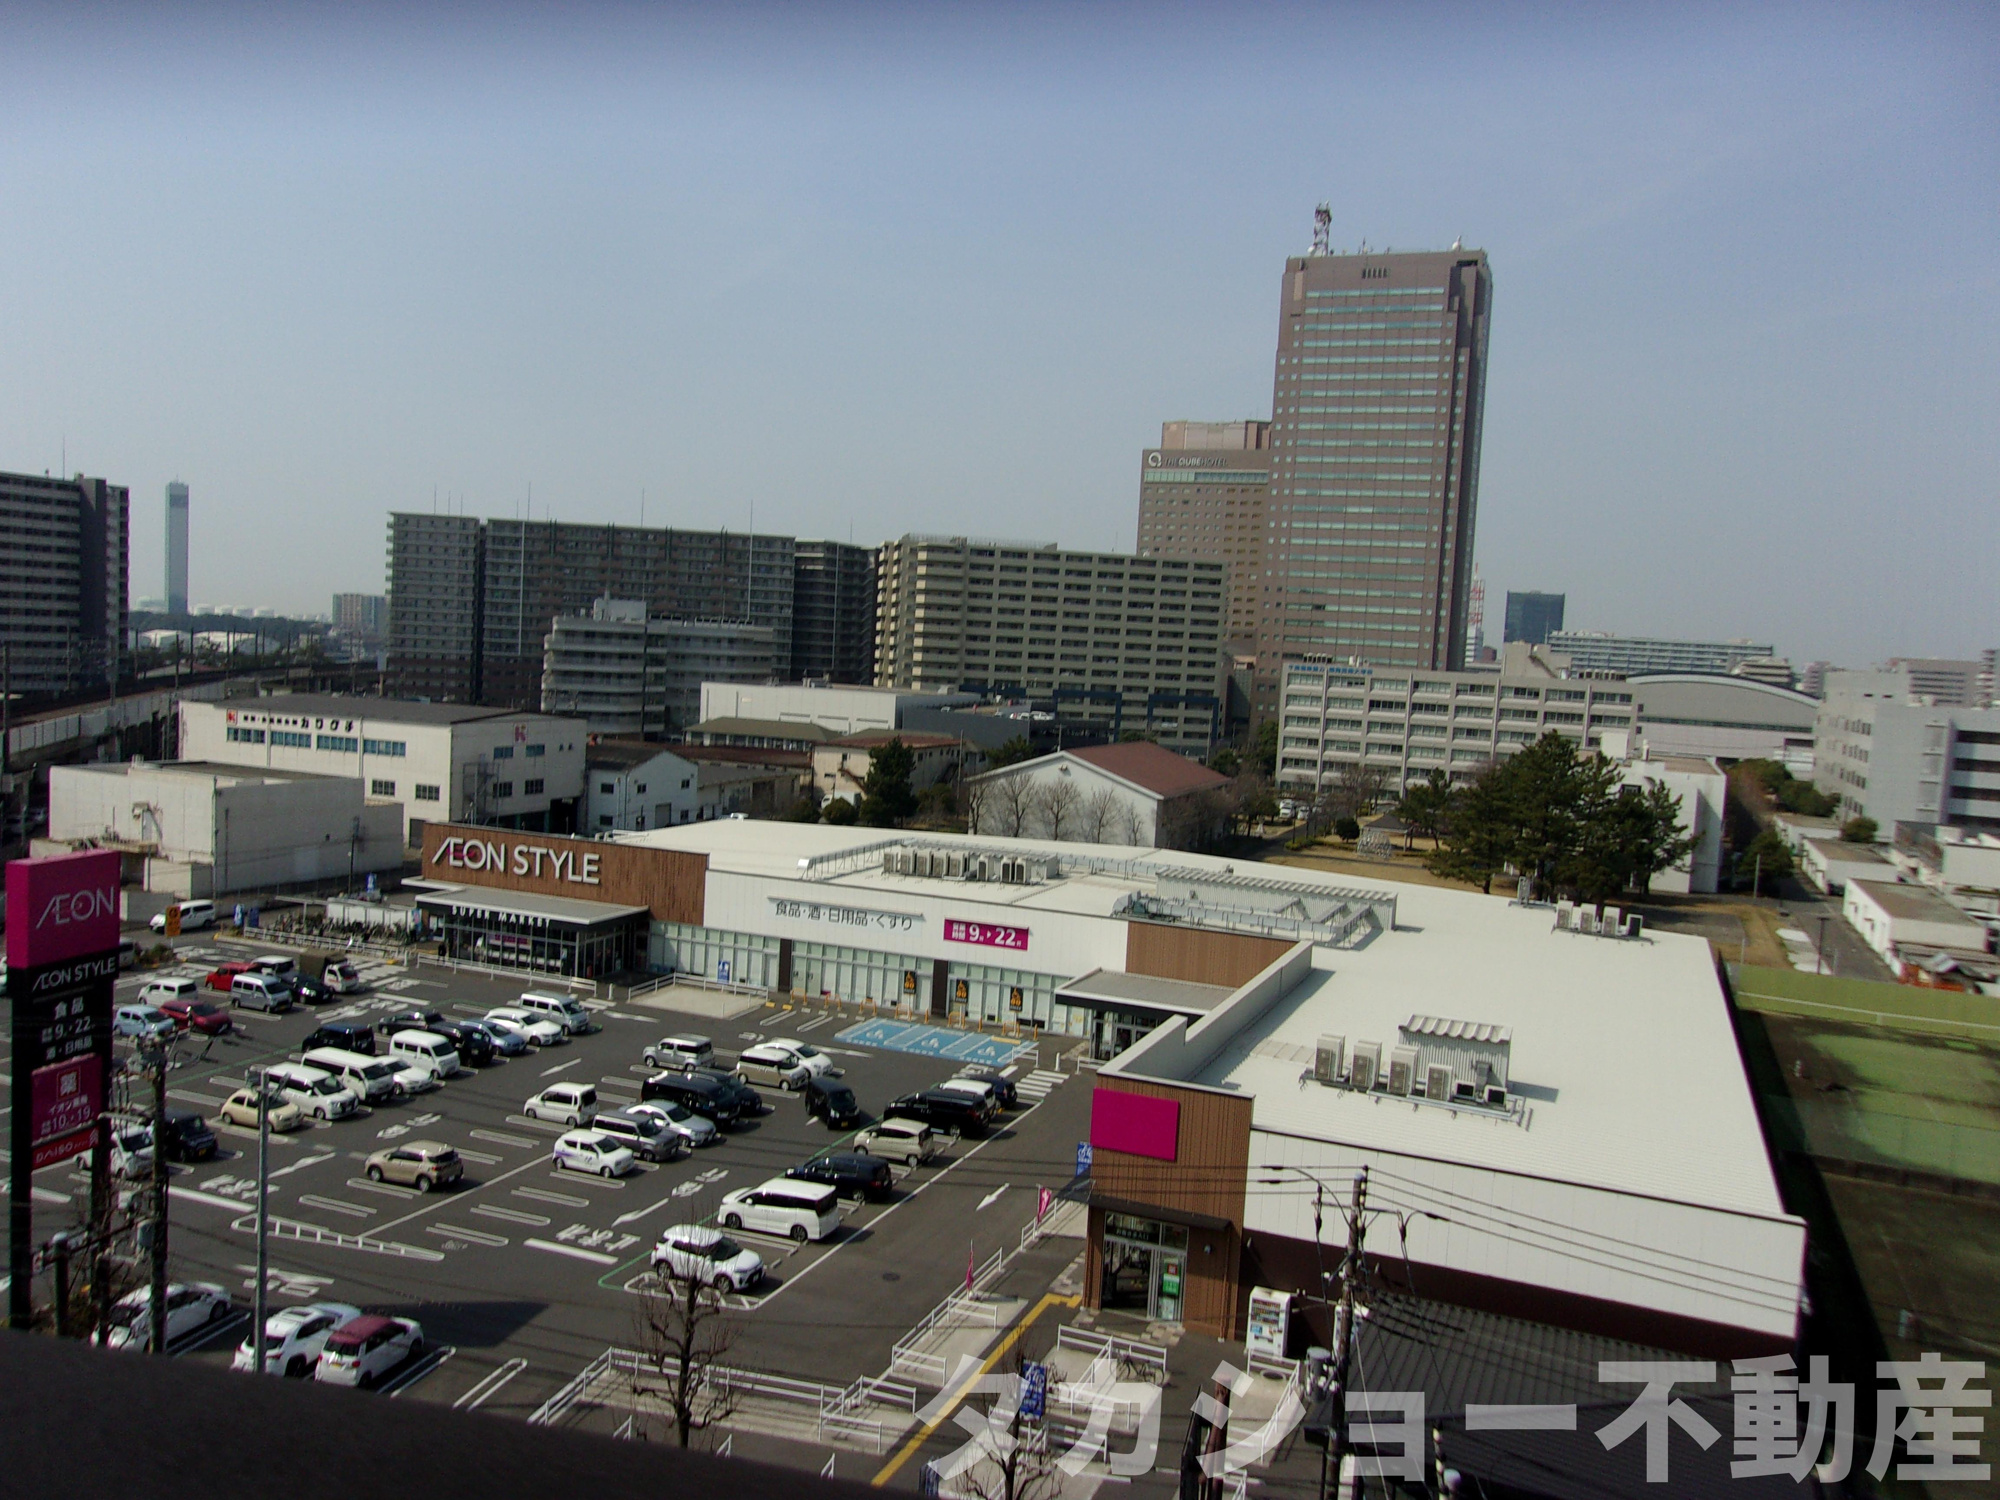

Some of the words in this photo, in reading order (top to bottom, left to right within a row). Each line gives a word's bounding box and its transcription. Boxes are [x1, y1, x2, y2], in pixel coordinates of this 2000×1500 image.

[513, 844, 600, 884] STYLE
[452, 905, 490, 920] SUPER
[498, 912, 550, 928] MARKET
[75, 957, 116, 981] STYLE
